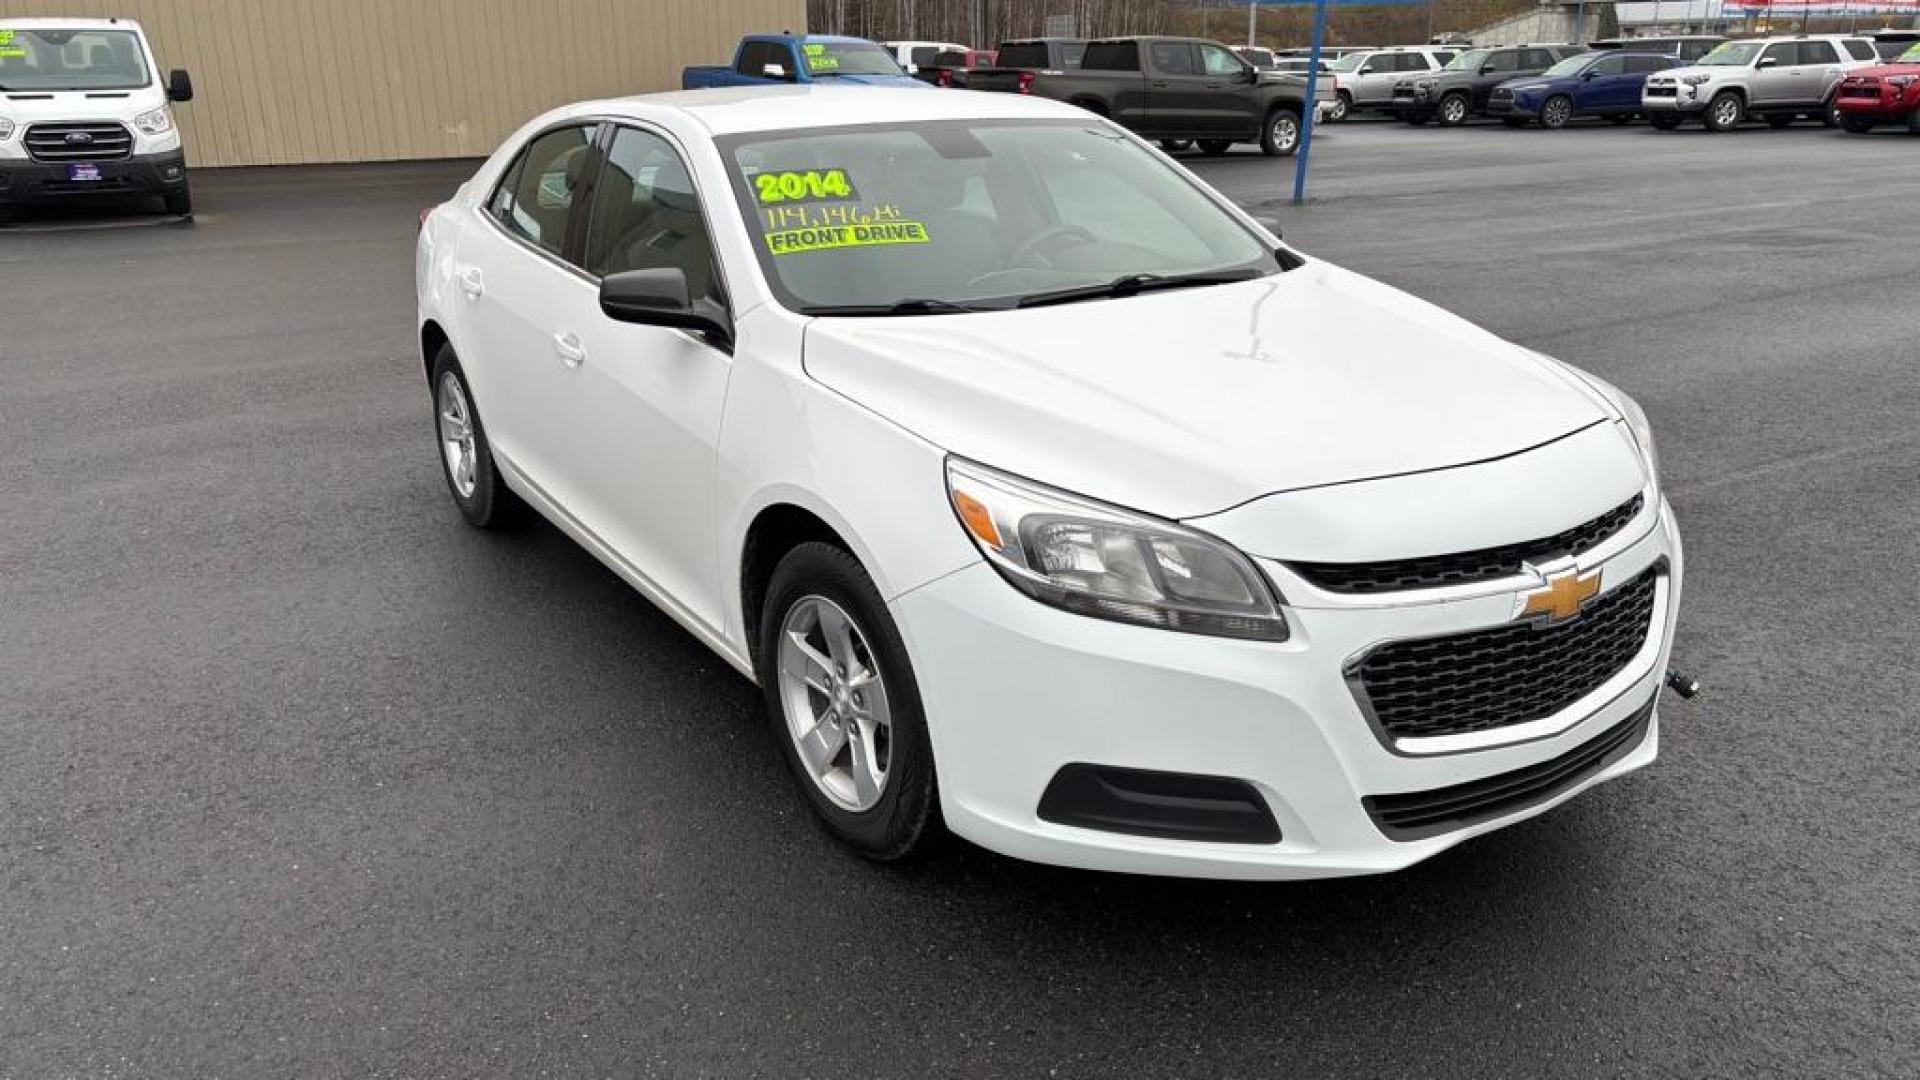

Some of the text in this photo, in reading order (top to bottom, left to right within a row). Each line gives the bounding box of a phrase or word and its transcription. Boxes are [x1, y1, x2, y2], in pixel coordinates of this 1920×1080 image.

[757, 170, 851, 201] 2014
[771, 223, 922, 250] FRONT DRIVE
